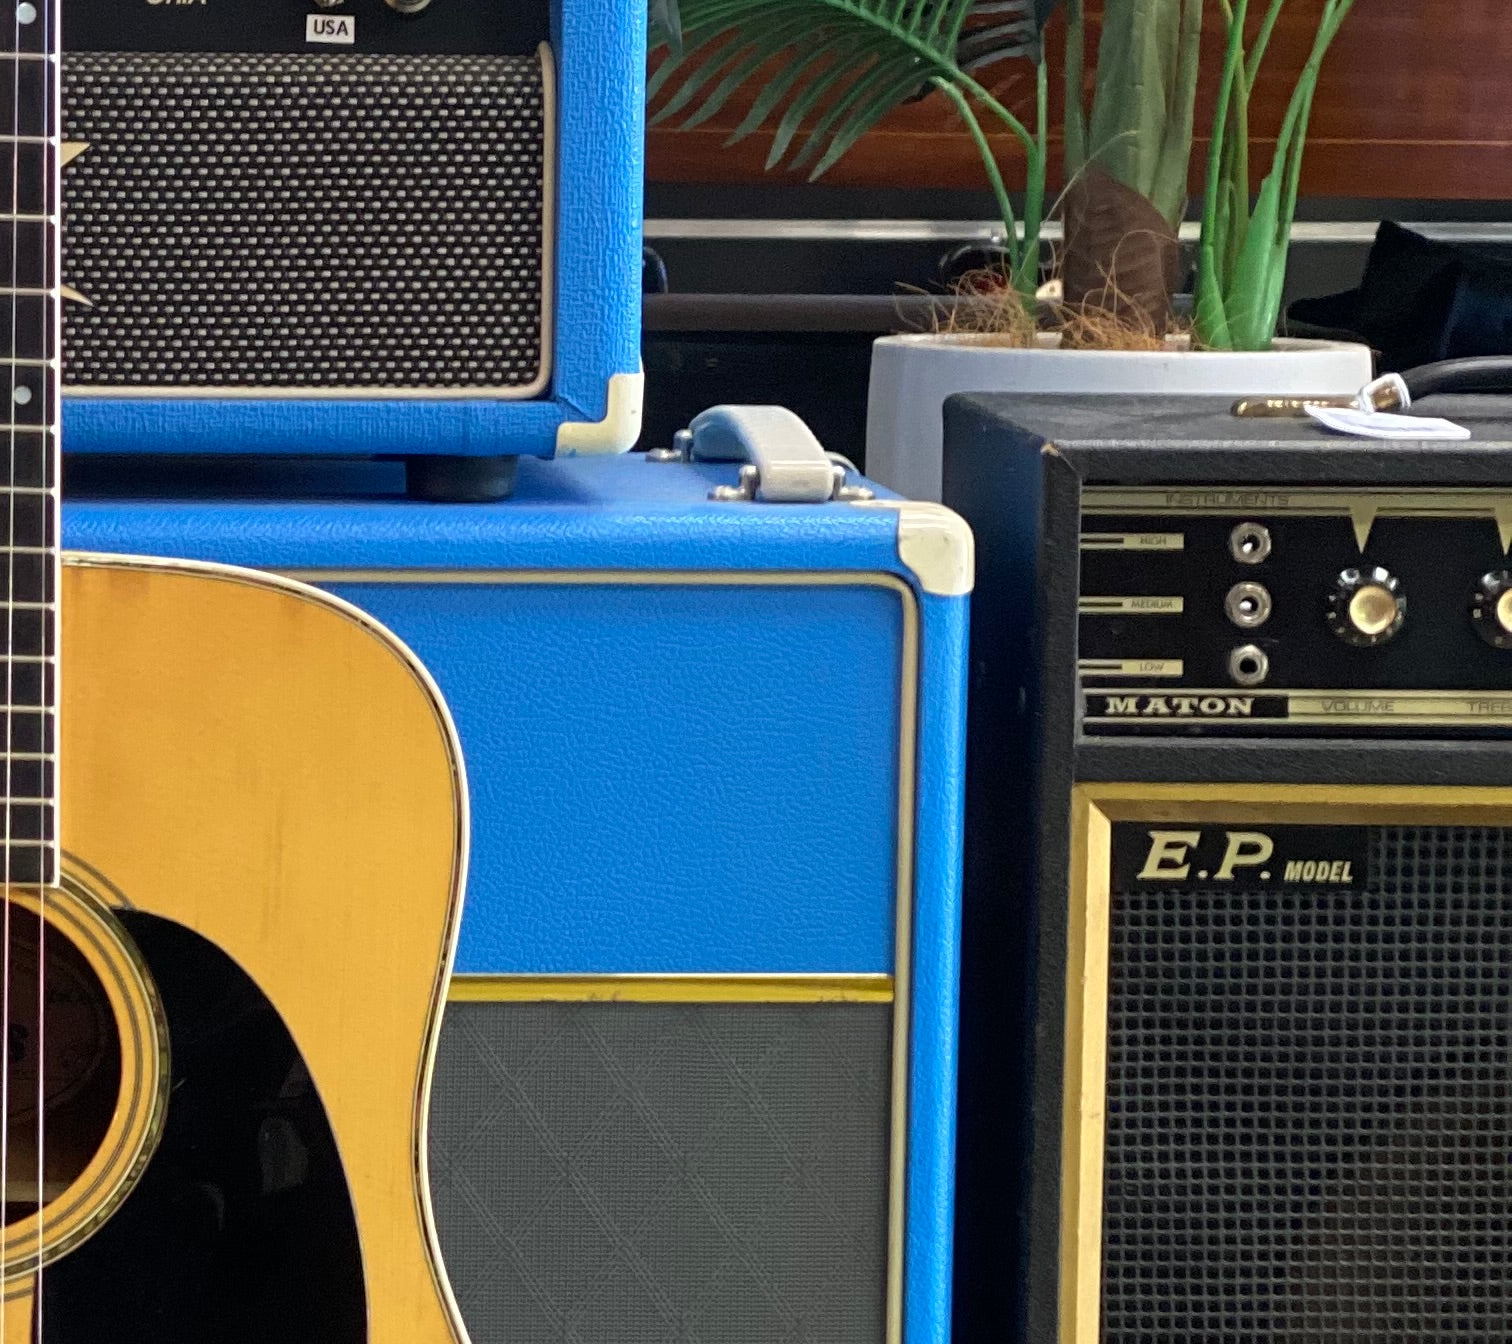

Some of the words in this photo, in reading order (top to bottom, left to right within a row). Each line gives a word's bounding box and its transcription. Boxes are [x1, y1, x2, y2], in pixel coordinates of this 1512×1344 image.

[313, 19, 349, 37] USA
[1165, 494, 1290, 506] INSTRUMENTS
[1139, 662, 1165, 673] LOW
[1105, 697, 1256, 716] MATON
[1321, 699, 1394, 713] VOLUME
[1137, 830, 1274, 882] E.P.
[1284, 860, 1354, 884] MODEL
